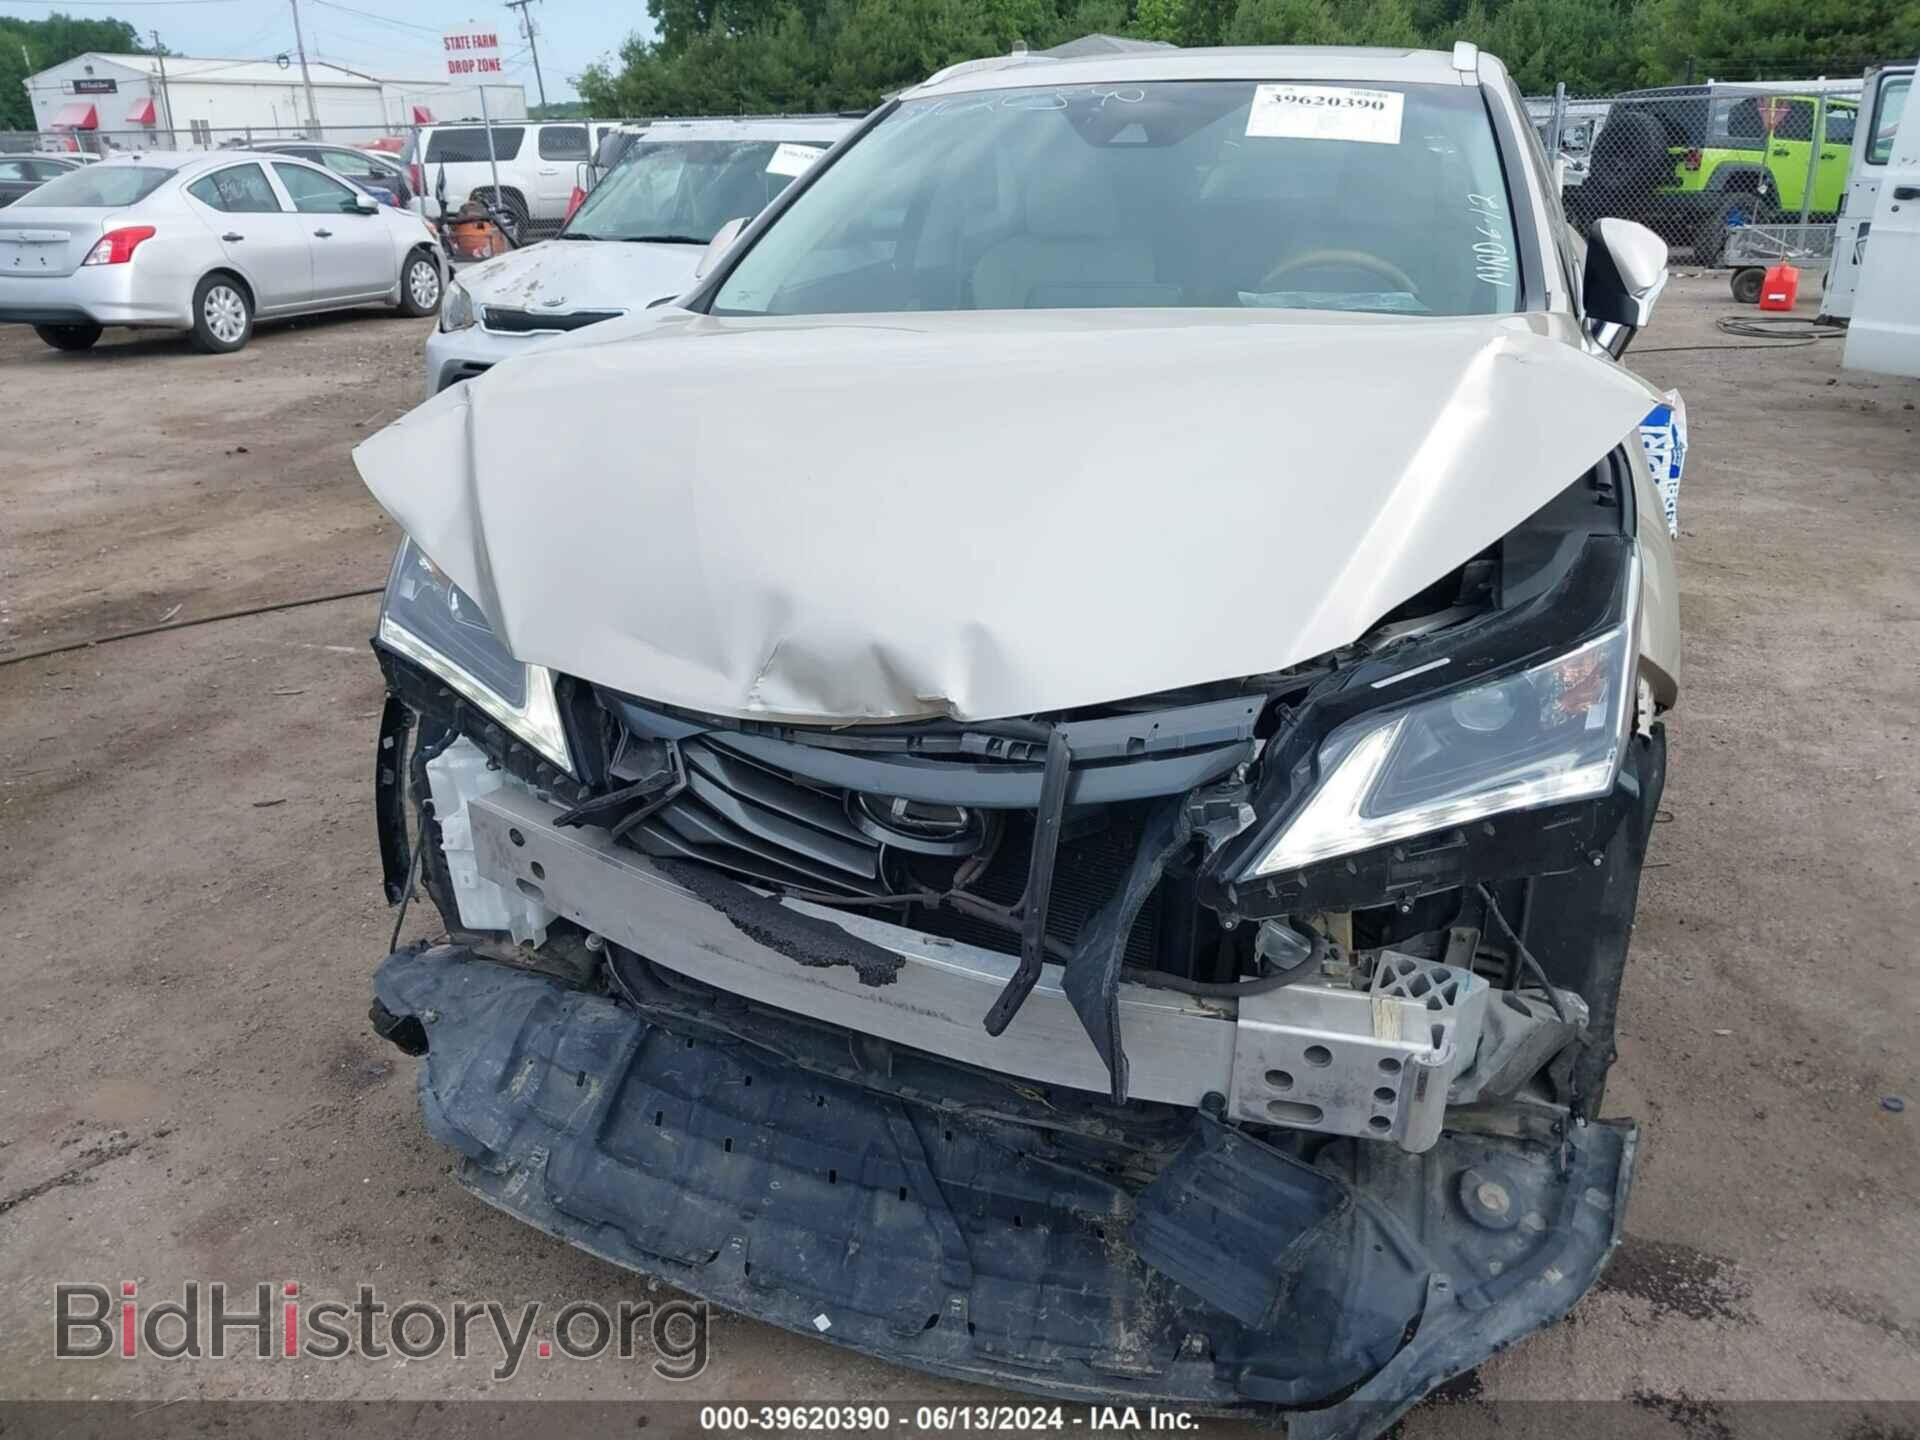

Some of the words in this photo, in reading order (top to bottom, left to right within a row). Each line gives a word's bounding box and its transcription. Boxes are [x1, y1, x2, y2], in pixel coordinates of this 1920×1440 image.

[443, 36, 471, 51] STATE
[472, 33, 498, 48] FARM
[447, 59, 475, 74] DROP
[477, 58, 502, 73] ZONE
[1269, 93, 1385, 111] 39620390
